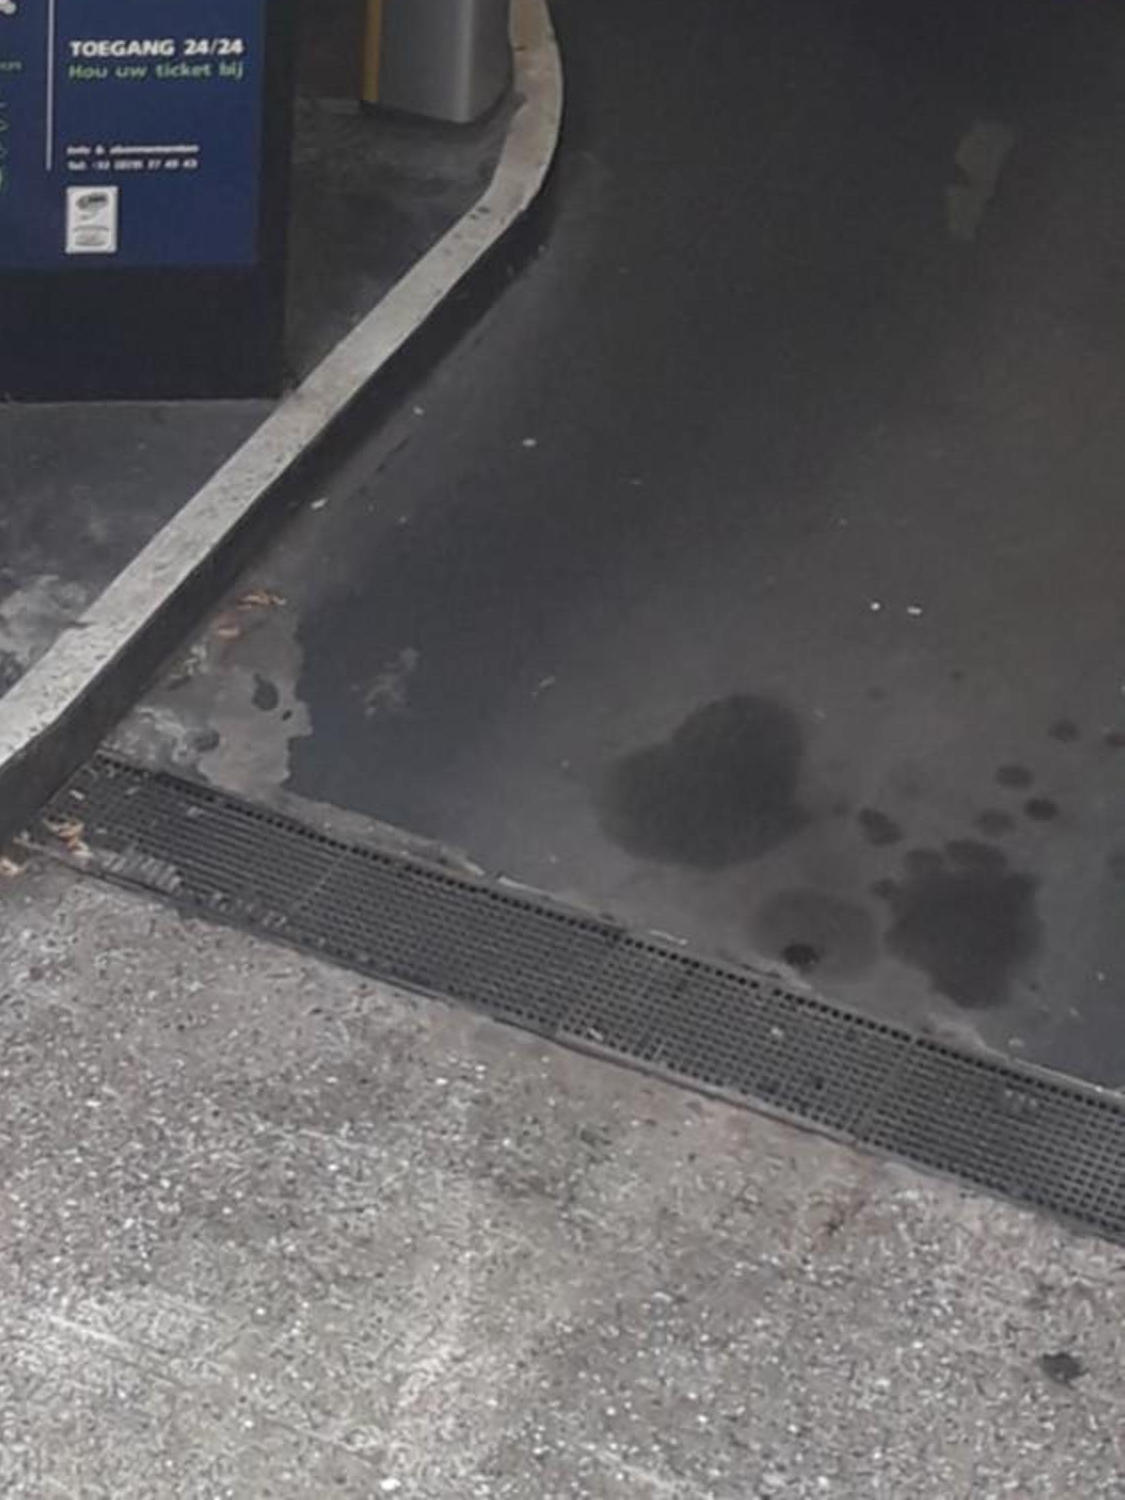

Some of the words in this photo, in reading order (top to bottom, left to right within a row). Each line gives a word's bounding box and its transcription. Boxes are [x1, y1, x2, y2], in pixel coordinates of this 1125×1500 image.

[69, 40, 175, 57] TOEGANG
[183, 38, 244, 56] 24/24
[68, 65, 108, 79] Hou
[115, 64, 149, 78] uw
[154, 62, 212, 77] ticket
[218, 60, 244, 81] bij
